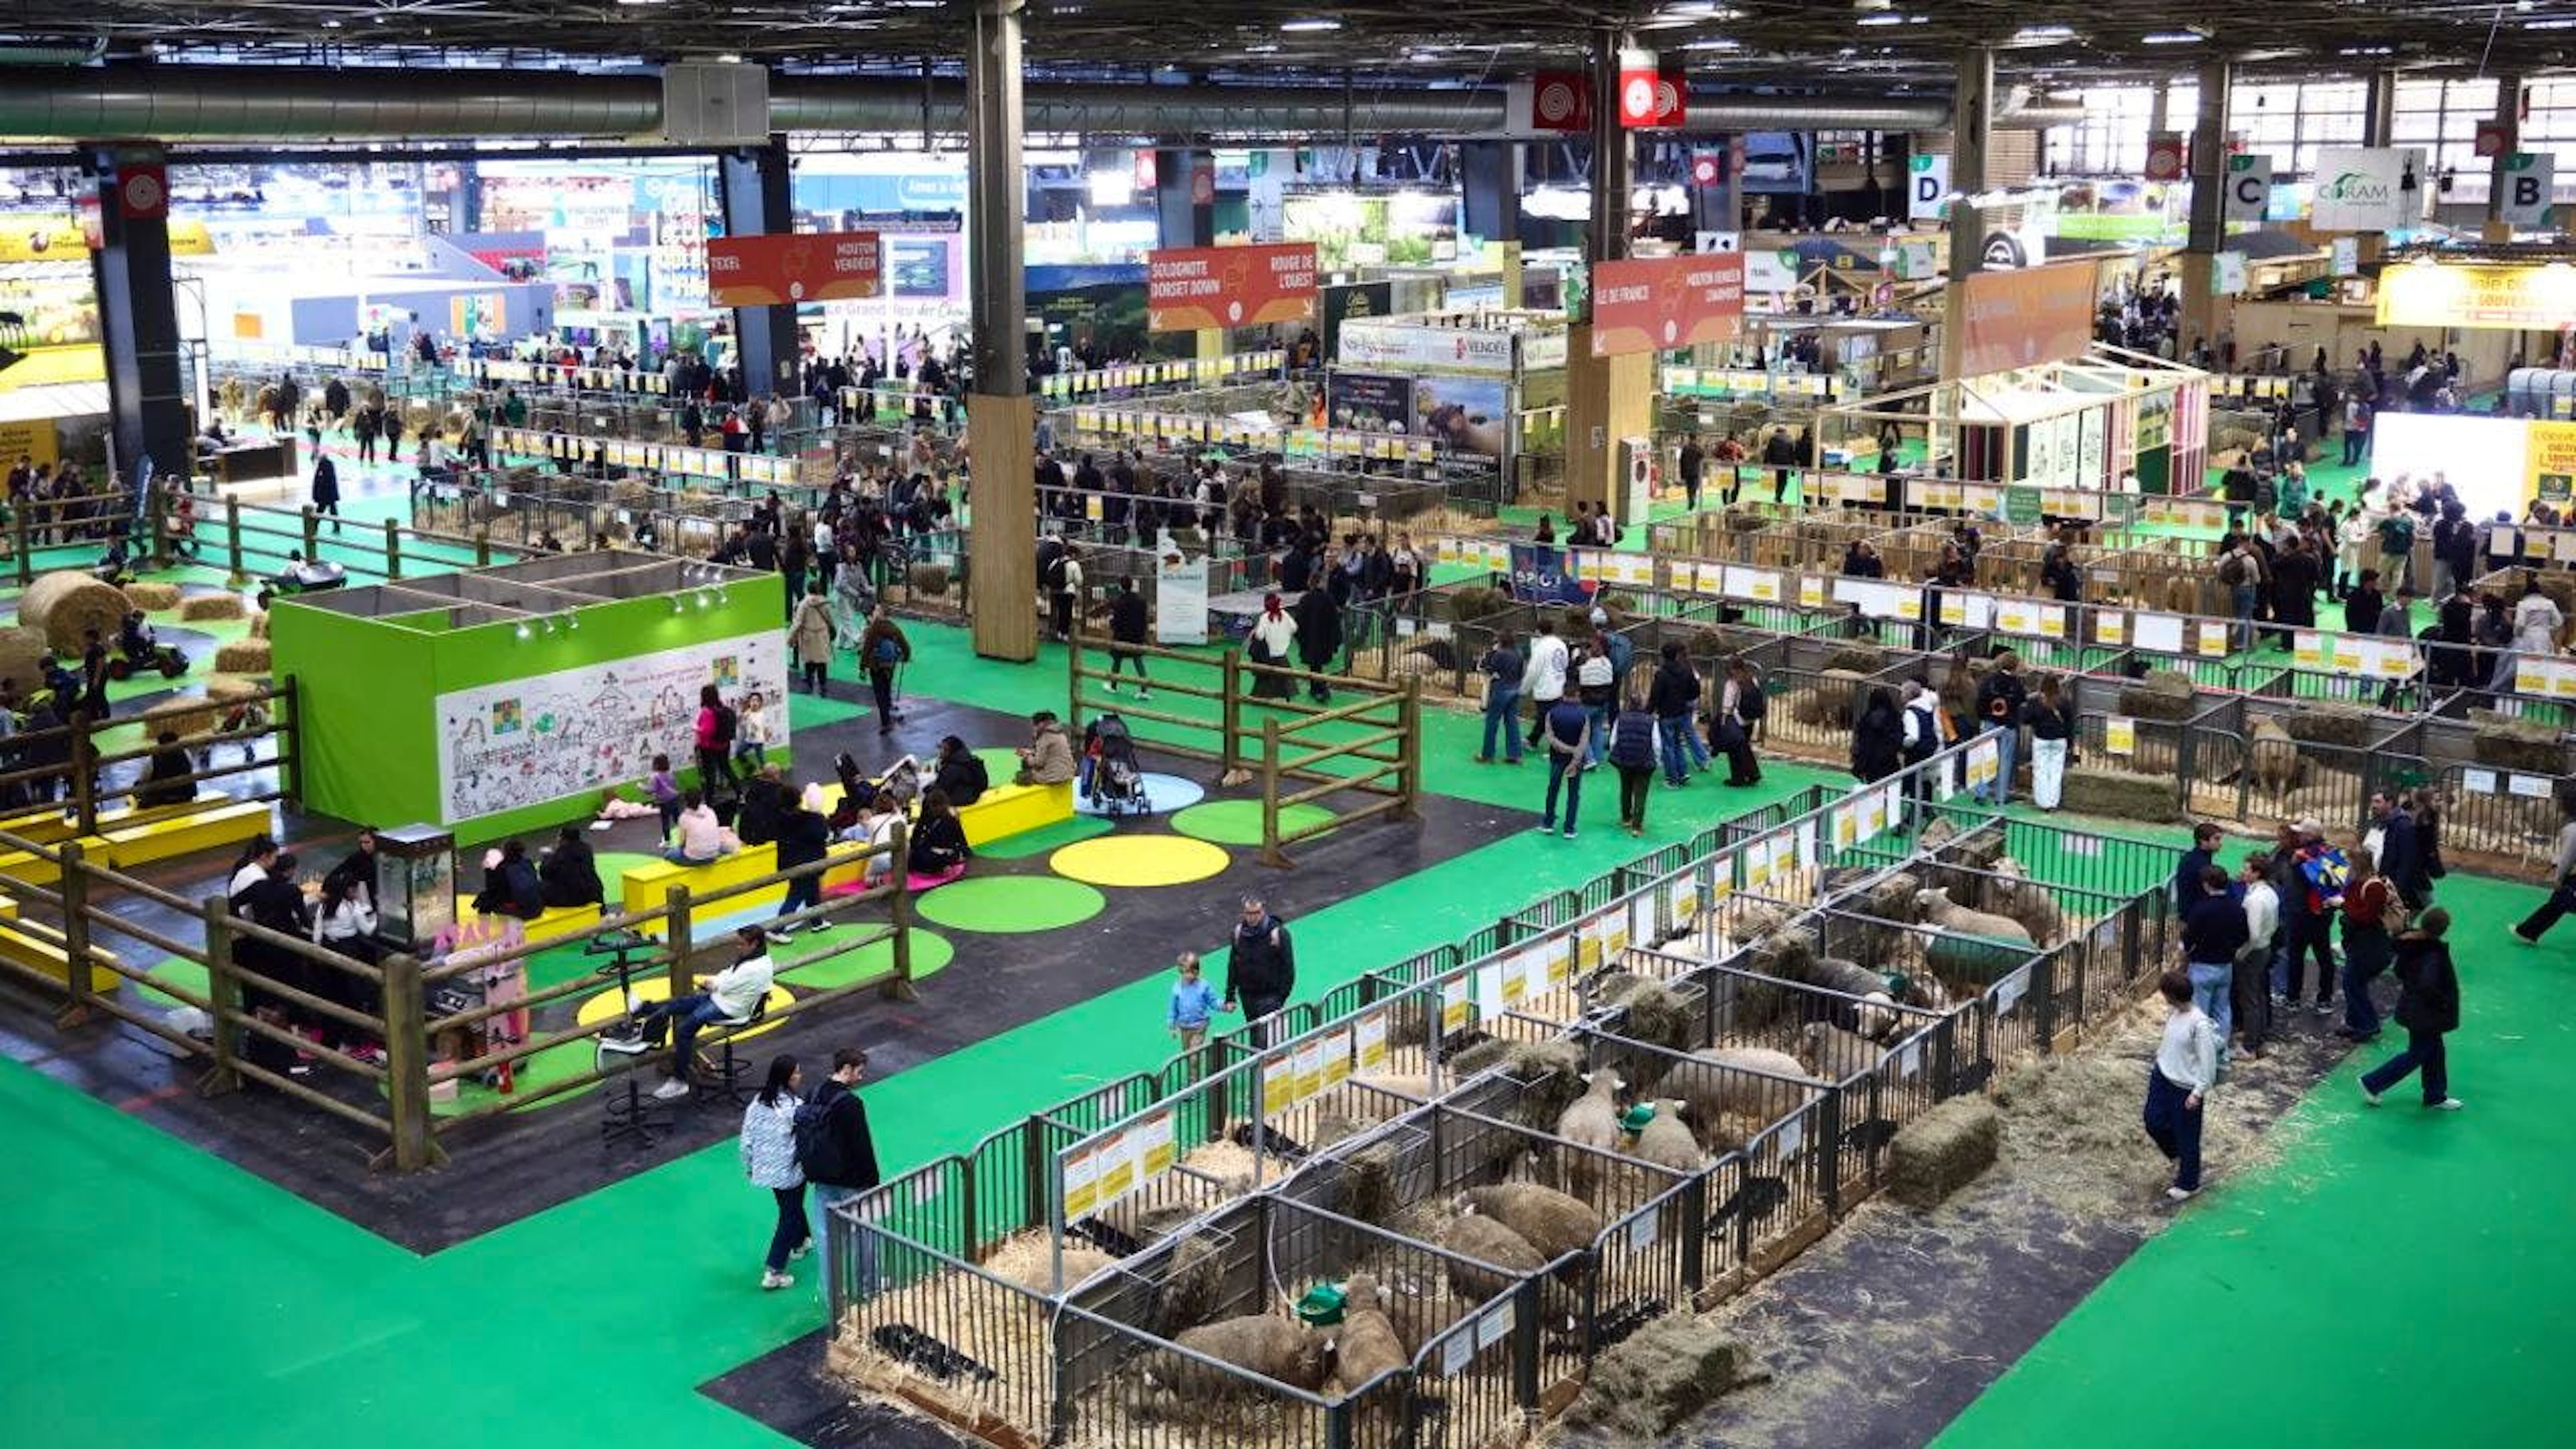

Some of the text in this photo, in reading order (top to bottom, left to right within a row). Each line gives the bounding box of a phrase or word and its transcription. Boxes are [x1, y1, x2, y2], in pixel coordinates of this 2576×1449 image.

[1919, 177, 1939, 202] D
[2237, 176, 2262, 204] C
[2514, 176, 2540, 207] B
[836, 241, 876, 256] MOUTON
[711, 256, 741, 272] TEXEL
[1152, 260, 1208, 278] SOLOGNOTE
[1271, 254, 1313, 271] ROUGE DE
[1150, 278, 1222, 298] DORSET DOWN
[1279, 271, 1313, 289] L'OUEST
[1622, 284, 1650, 301] FRANCE
